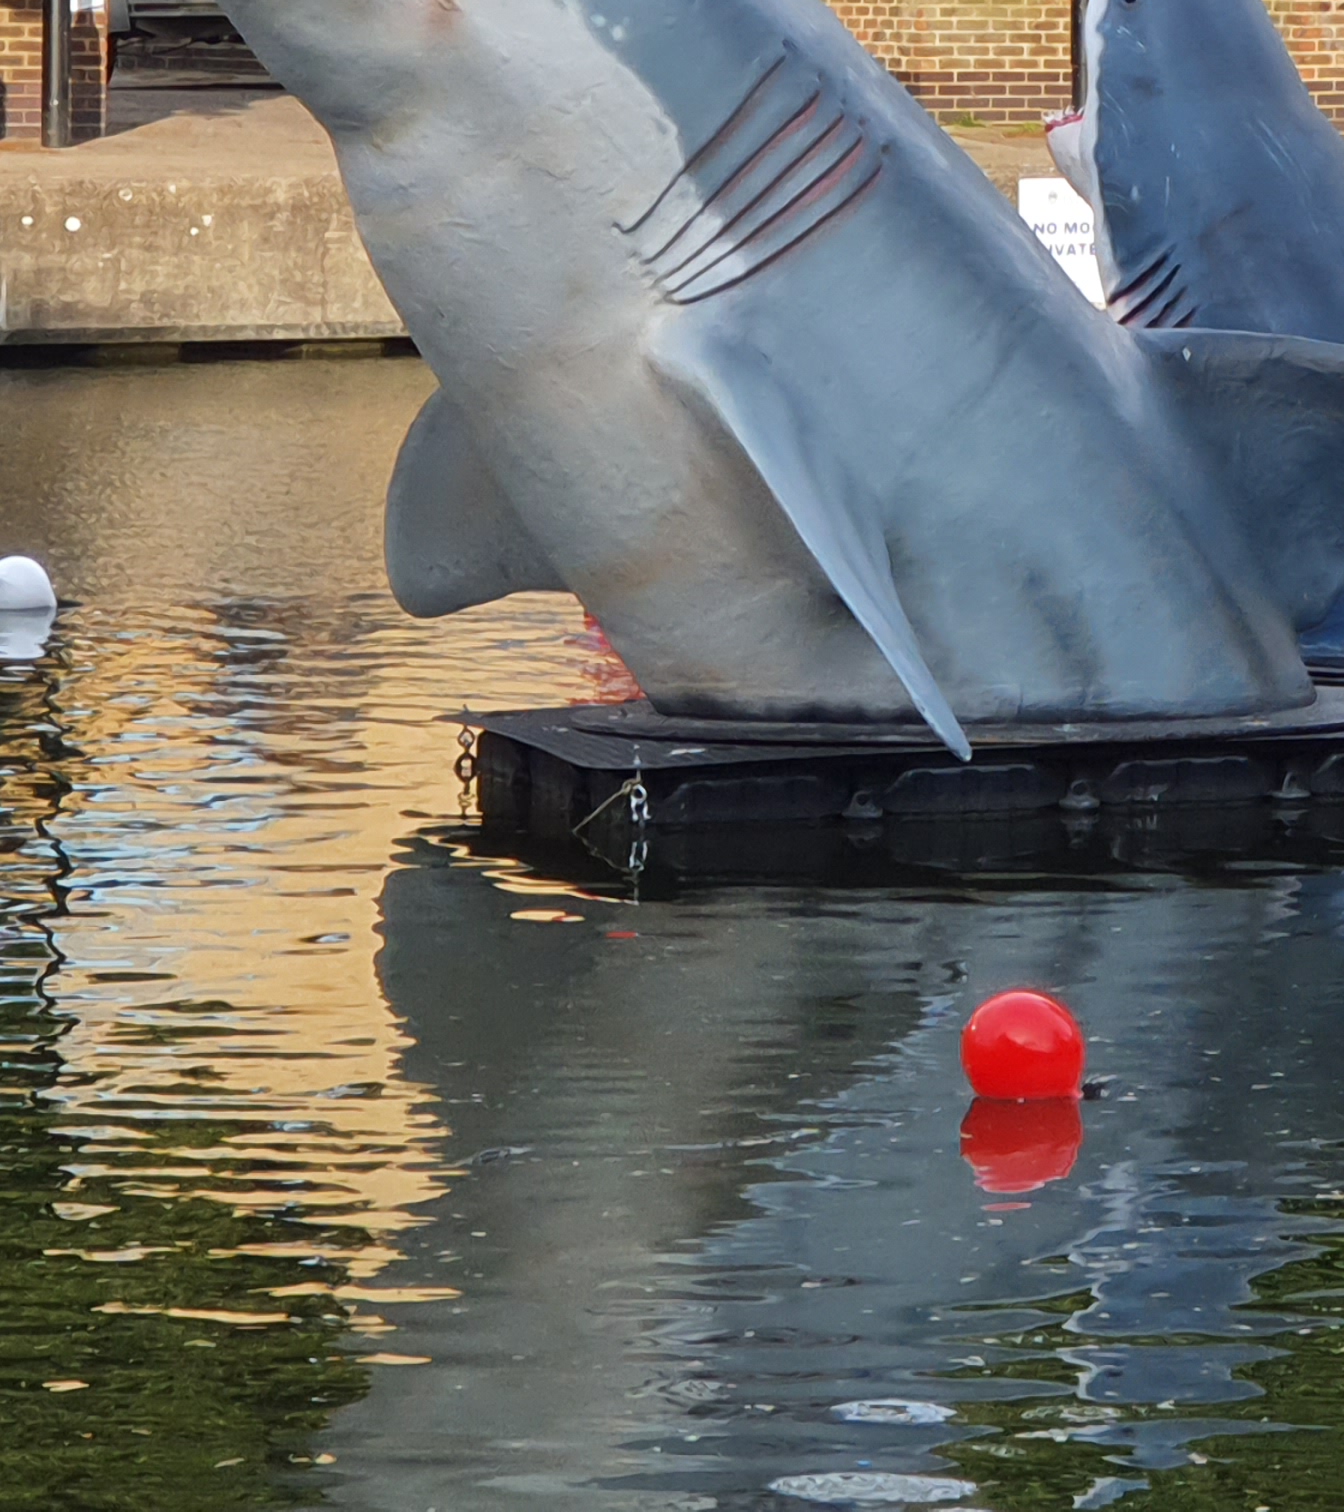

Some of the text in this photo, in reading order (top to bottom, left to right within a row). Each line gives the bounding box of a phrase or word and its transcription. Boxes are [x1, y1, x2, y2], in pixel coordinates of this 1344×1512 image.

[1033, 222, 1094, 234] NO MO
[1048, 243, 1096, 256] IVATE
